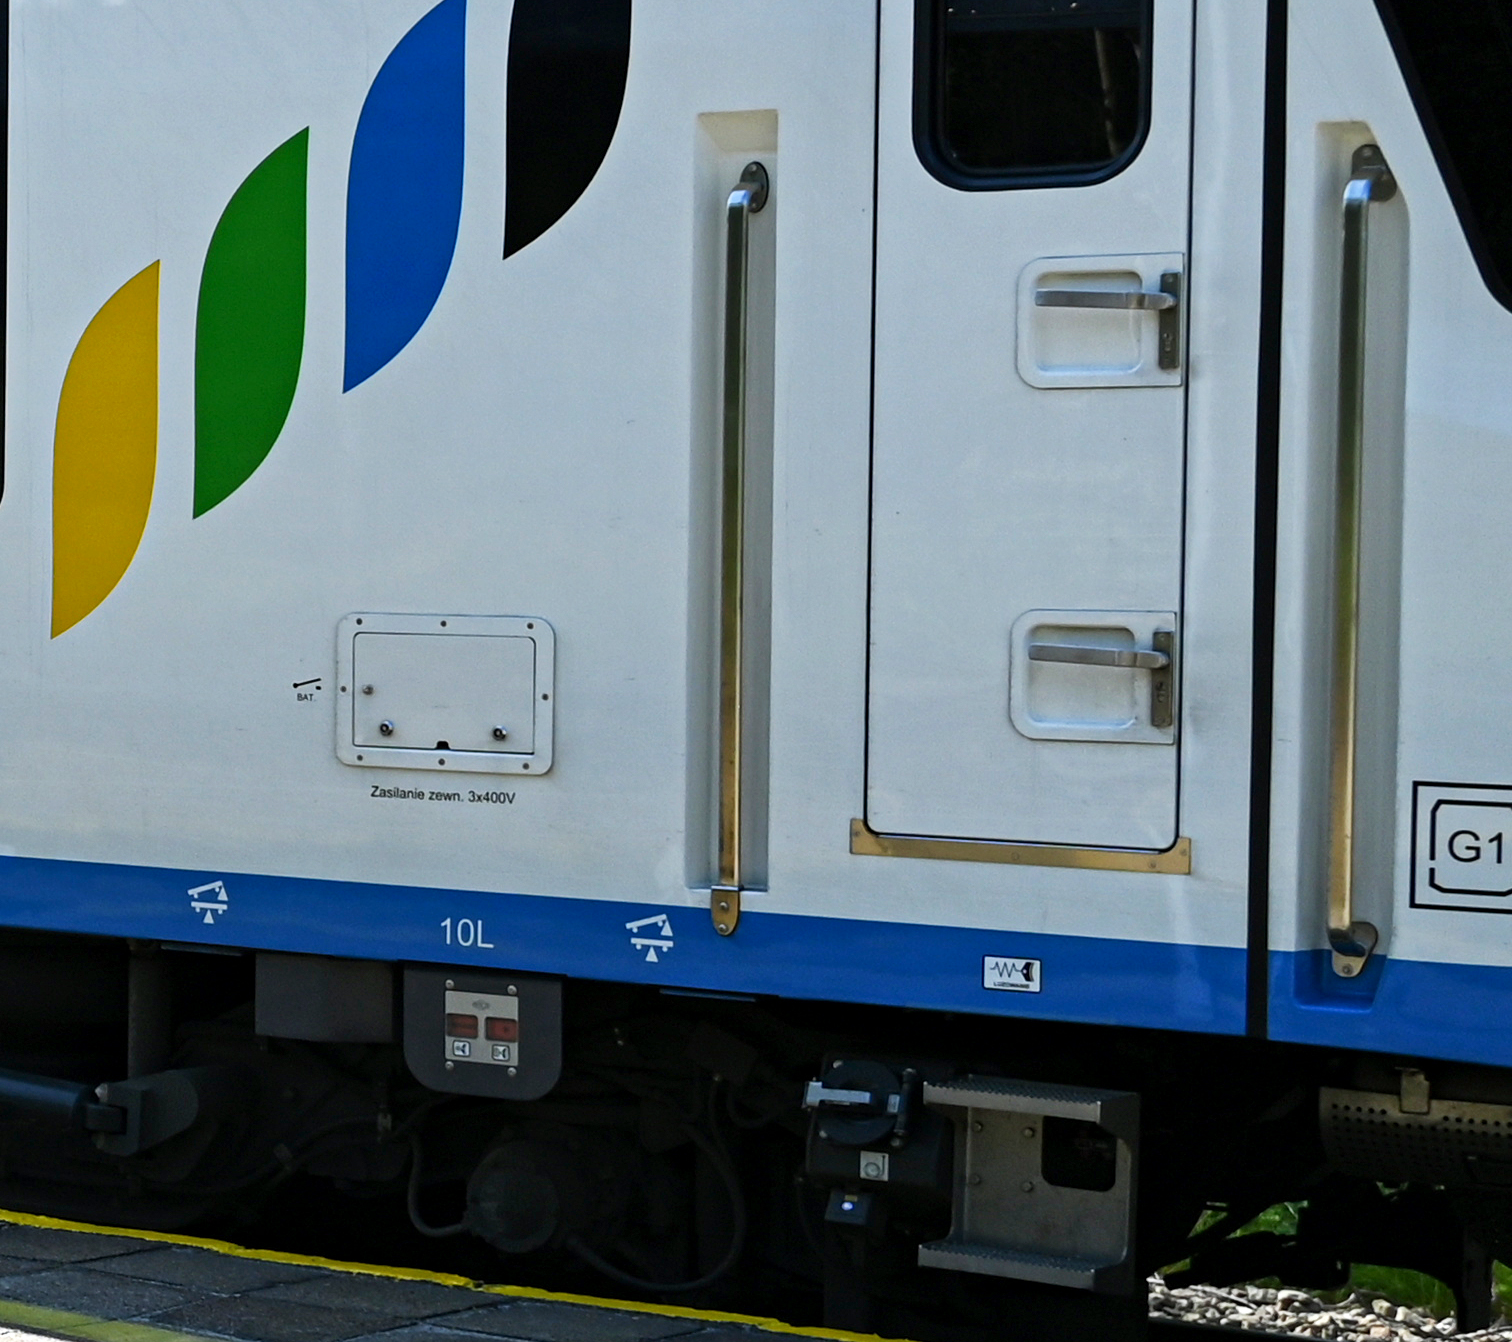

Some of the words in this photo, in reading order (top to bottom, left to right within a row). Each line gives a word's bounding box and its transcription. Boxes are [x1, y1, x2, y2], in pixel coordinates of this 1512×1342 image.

[370, 785, 425, 801] Zasilanie
[428, 791, 464, 802] zewn.
[467, 790, 516, 804] 3x400V
[1448, 829, 1503, 864] G1
[440, 917, 495, 949] 10L
